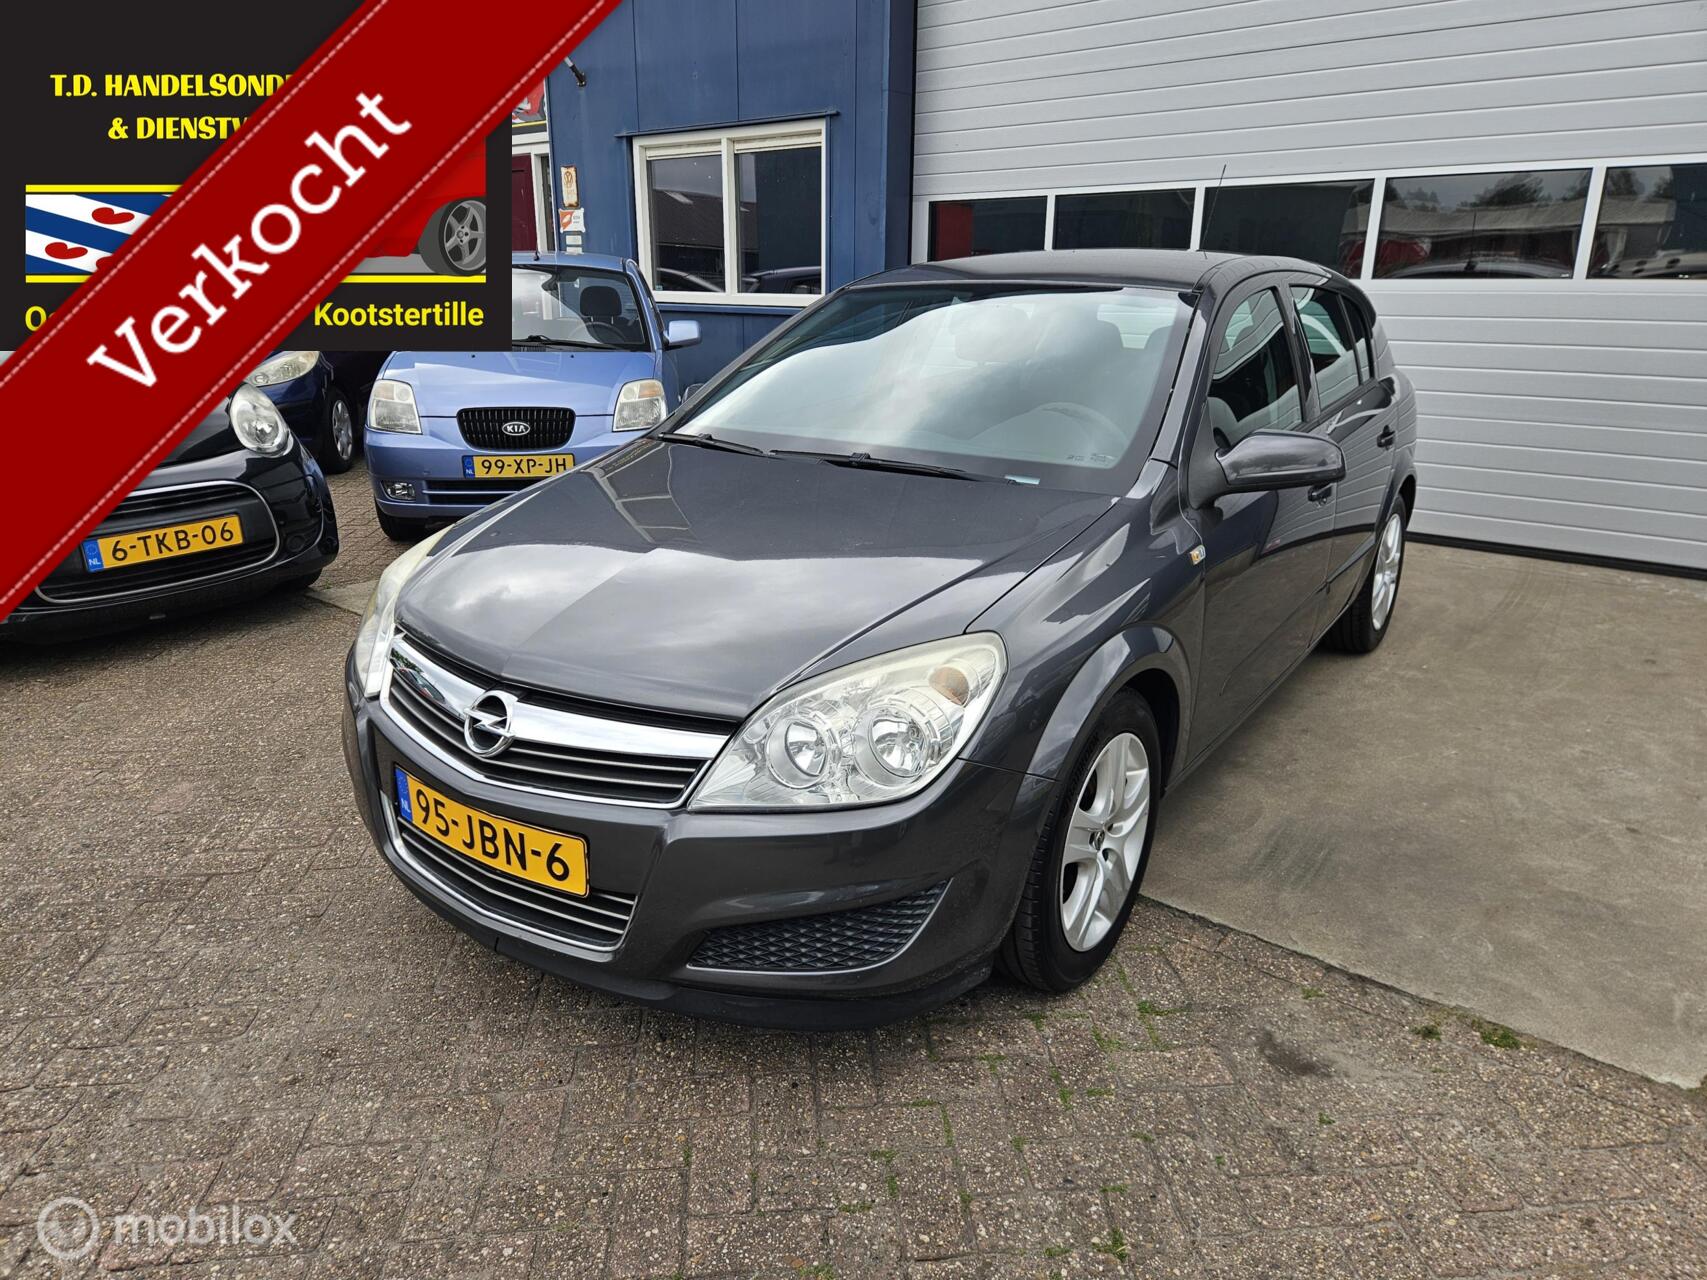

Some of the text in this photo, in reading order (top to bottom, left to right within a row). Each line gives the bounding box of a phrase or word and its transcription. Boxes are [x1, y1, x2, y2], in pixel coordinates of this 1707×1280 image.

[506, 424, 527, 433] KIA
[481, 457, 567, 475] 99-XP-JH
[88, 521, 235, 566] NL 6-TKB-06
[400, 787, 571, 882] NL 95-JBN-6
